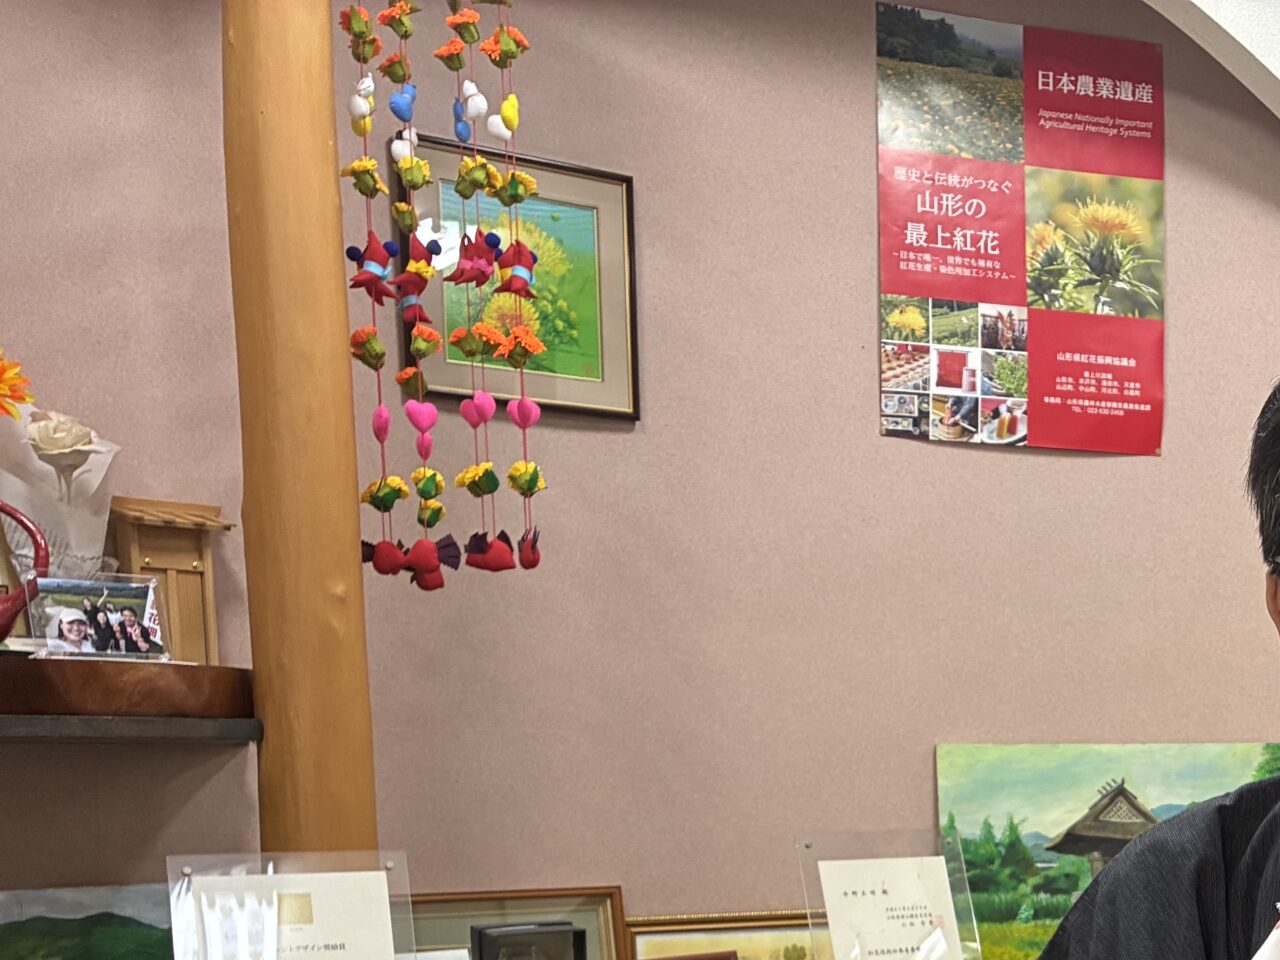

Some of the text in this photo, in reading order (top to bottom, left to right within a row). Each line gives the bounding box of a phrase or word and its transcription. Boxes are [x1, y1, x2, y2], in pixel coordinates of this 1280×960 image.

[1038, 70, 1153, 104] 日本農業遺産
[1039, 108, 1152, 129] Japanese Nationally Important
[1039, 118, 1152, 138] Agricultural Heritage Systems
[894, 166, 1013, 194] 歴史と伝統がつなぐ
[917, 190, 986, 218] 山形の
[904, 222, 1000, 255] 最上紅花
